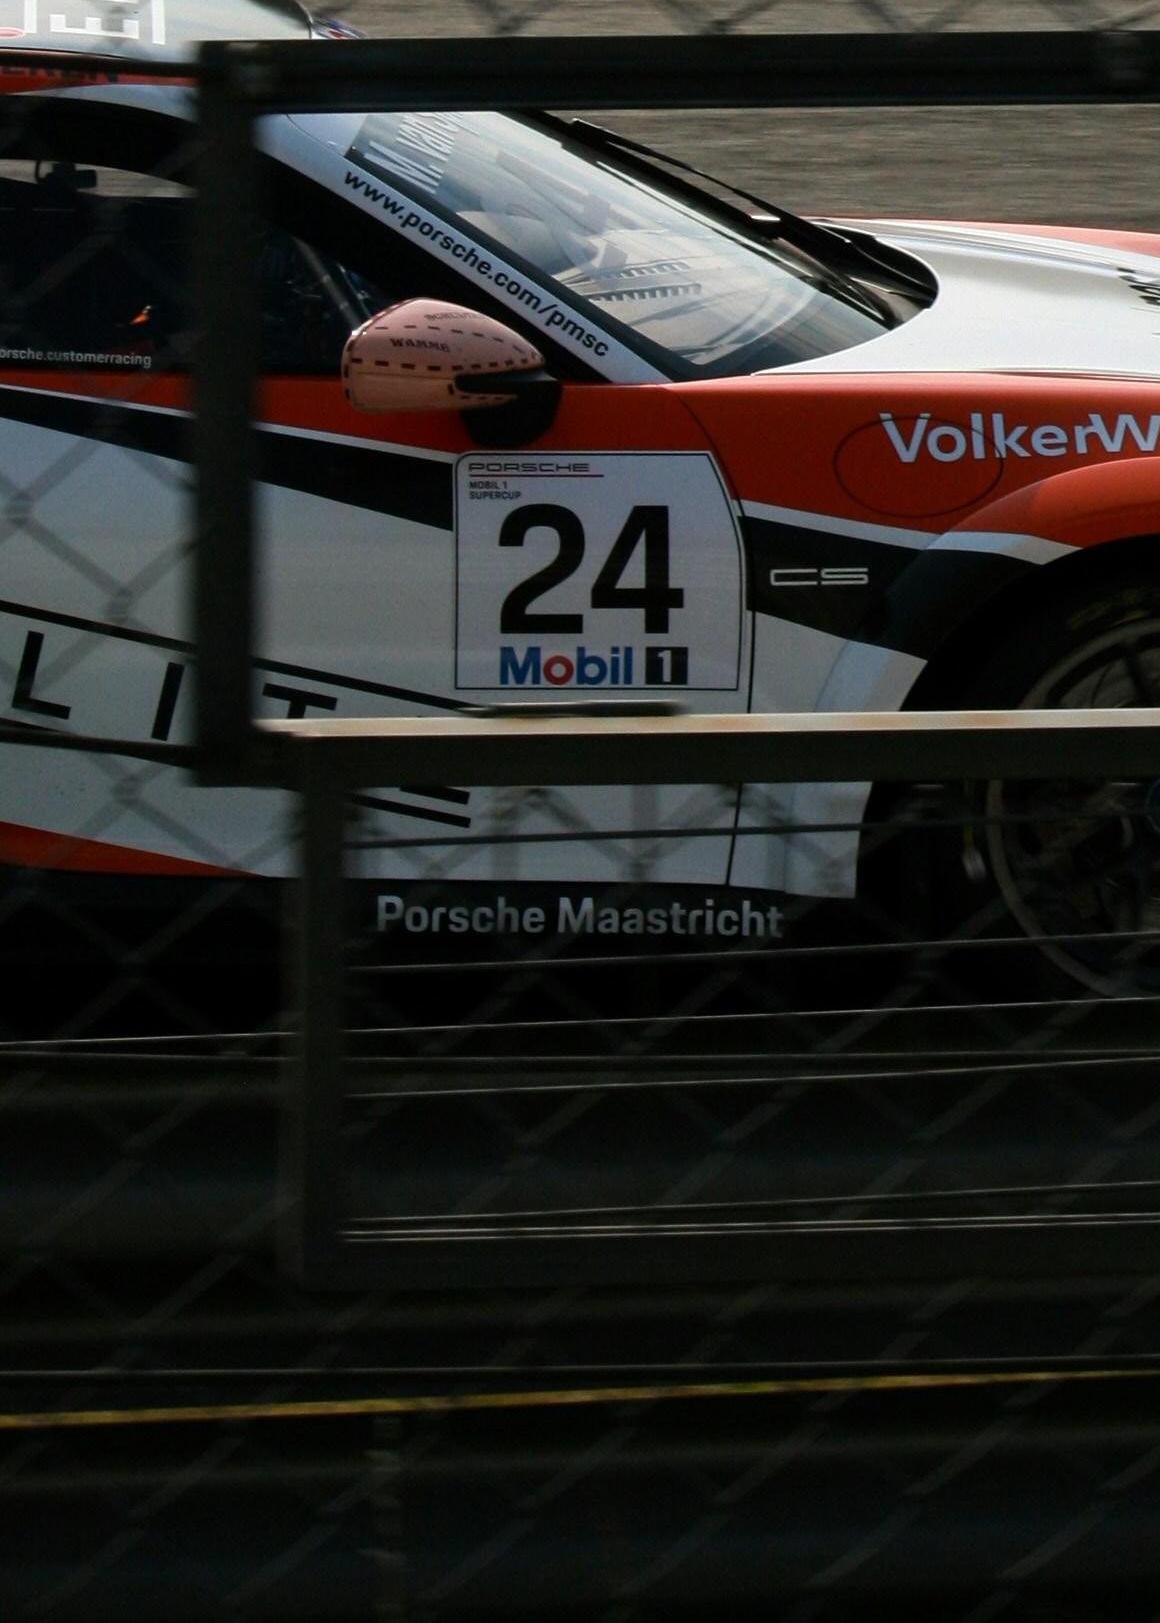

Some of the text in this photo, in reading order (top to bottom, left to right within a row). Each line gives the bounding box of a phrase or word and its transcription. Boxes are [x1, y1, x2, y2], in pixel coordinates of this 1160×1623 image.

[344, 170, 610, 358] www.porsche.com/pmsc
[468, 462, 590, 473] PORSCHE
[469, 481, 500, 490] MOBIL
[469, 490, 521, 500] SUPERCUP
[499, 503, 684, 634] 24
[770, 567, 869, 586] CS
[500, 646, 632, 686] Mobil
[376, 895, 784, 938] Porsche Maastricht
